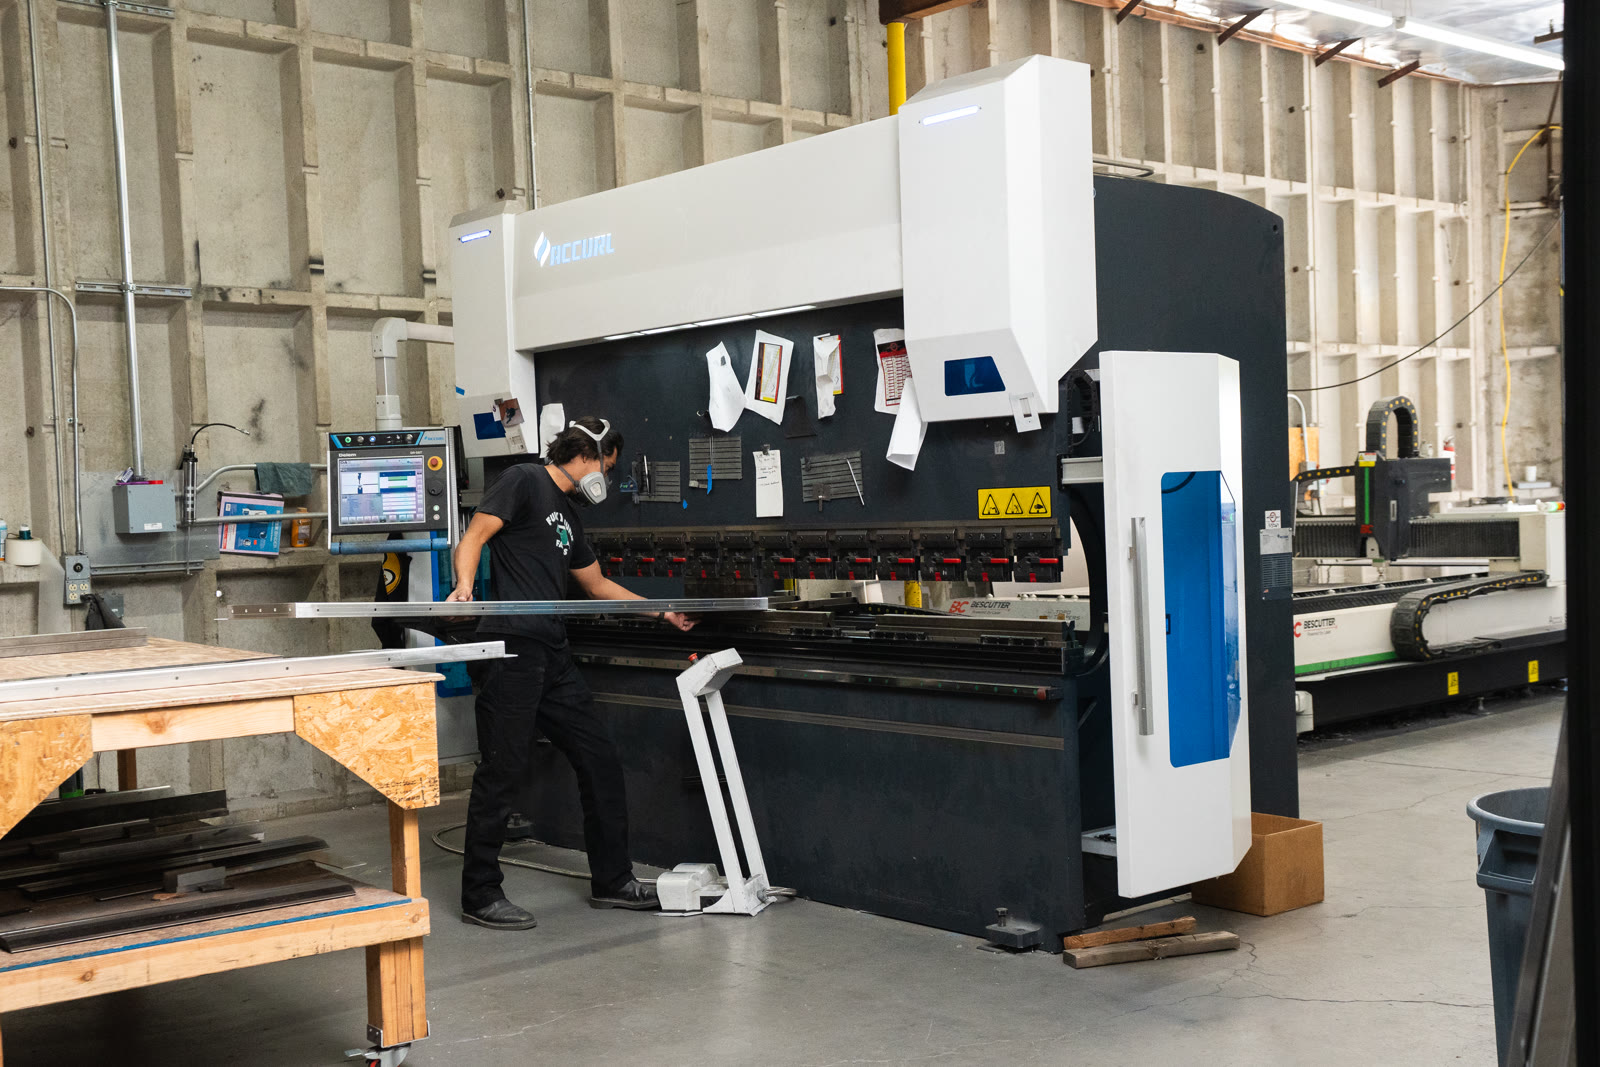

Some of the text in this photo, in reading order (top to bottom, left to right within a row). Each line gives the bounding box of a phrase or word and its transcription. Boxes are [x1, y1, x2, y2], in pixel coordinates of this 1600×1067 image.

[549, 233, 615, 266] ACCURL
[949, 600, 1010, 613] BC BESCUTTER
[1294, 621, 1302, 638] C
[1304, 618, 1335, 629] BESCUTTER
